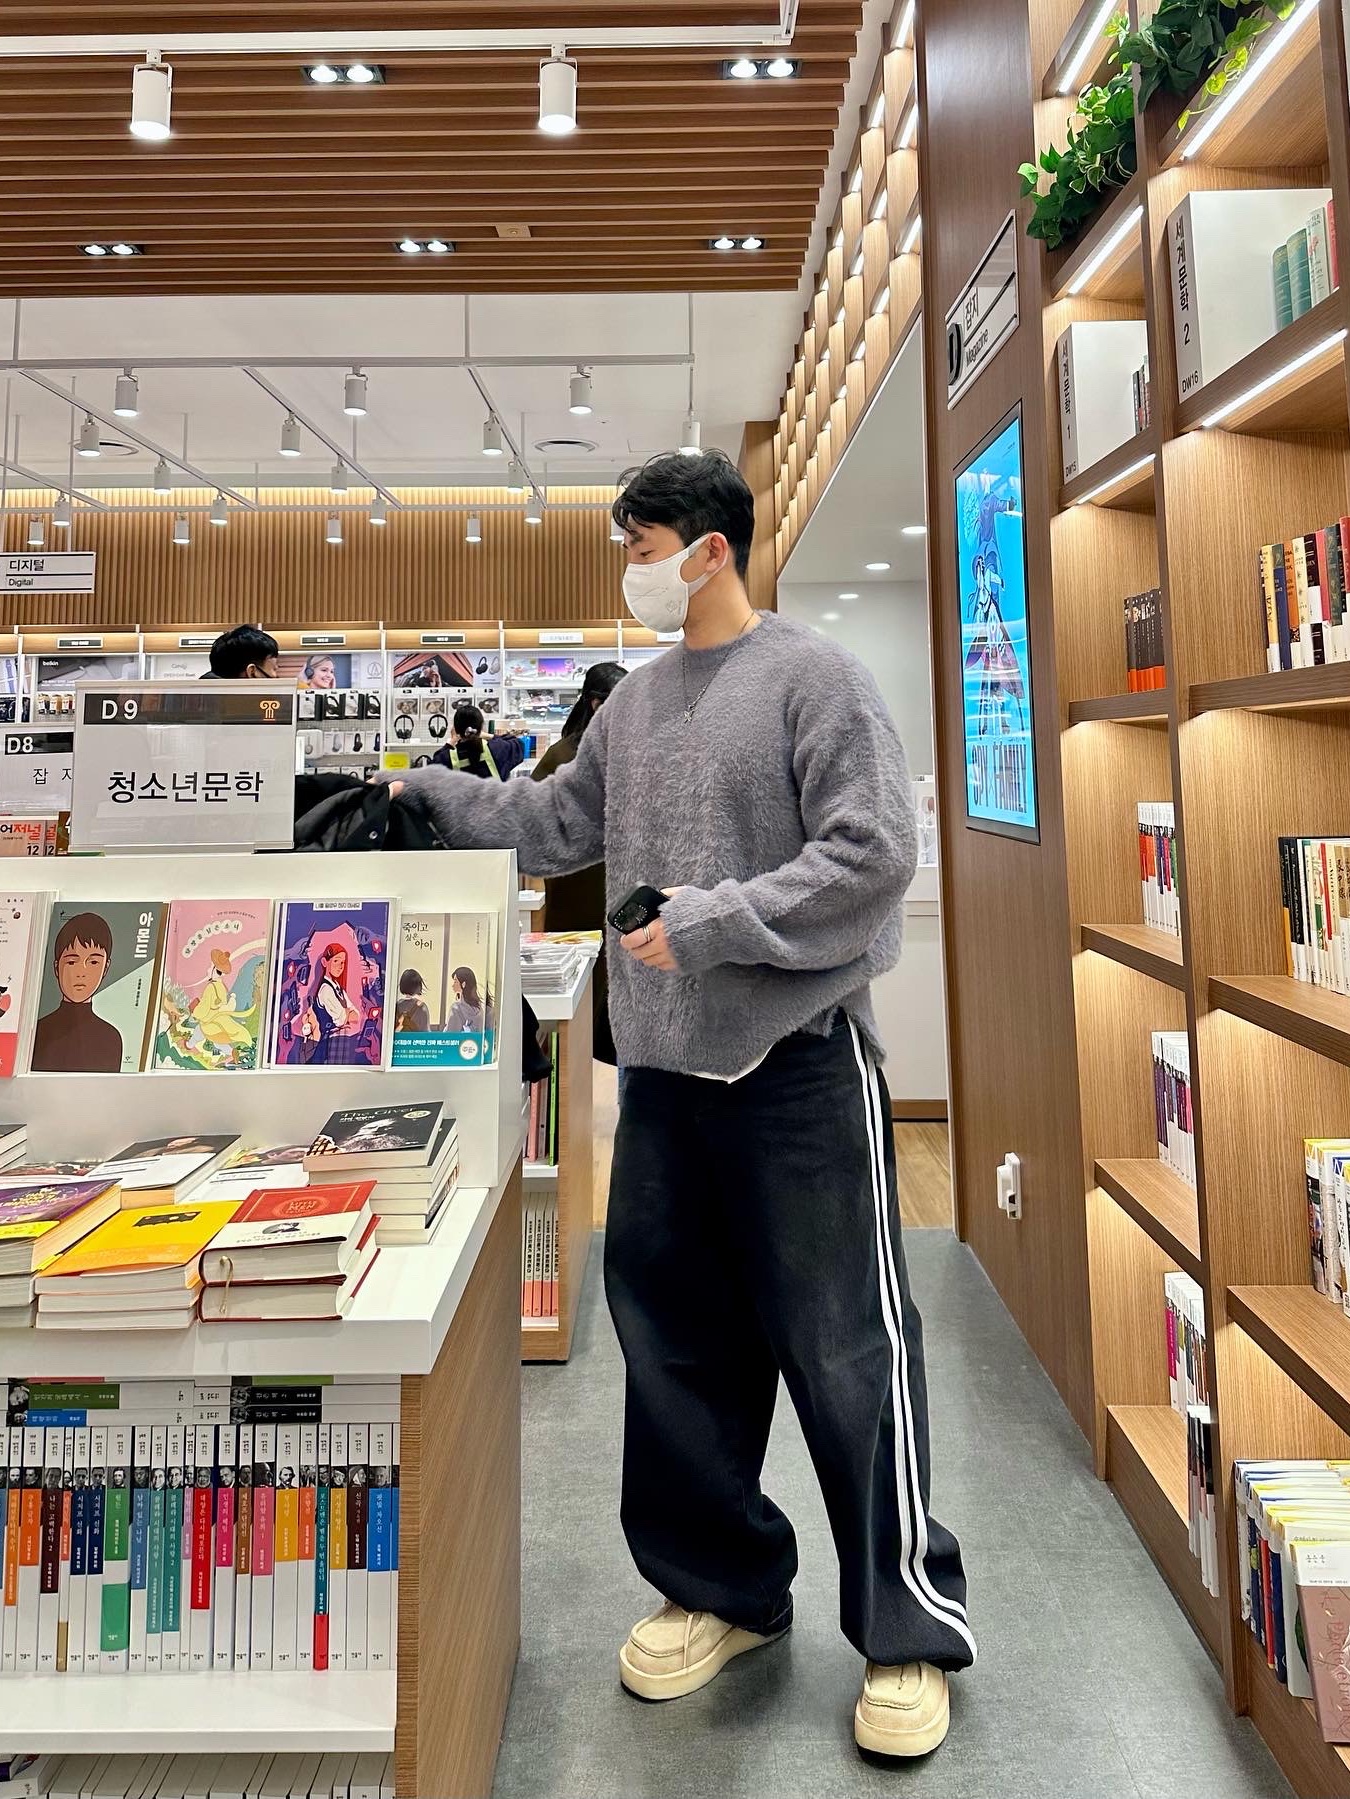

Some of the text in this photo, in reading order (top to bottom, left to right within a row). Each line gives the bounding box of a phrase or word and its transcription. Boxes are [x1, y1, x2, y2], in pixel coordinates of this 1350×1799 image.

[965, 286, 979, 331] 잡지
[1183, 322, 1191, 346] 2
[947, 322, 963, 386] D
[1181, 370, 1199, 393] DW16
[9, 559, 45, 572] 디지털
[8, 577, 34, 588] Digital
[7, 736, 34, 755] D8
[107, 770, 264, 803] 청소년문학
[971, 744, 989, 808] SPY
[992, 741, 1028, 814] FAMILY
[26, 845, 40, 856] 12
[133, 911, 154, 959] 아몬드
[402, 921, 429, 933] 죽이고
[405, 932, 418, 942] 싶은
[414, 938, 433, 951] 아이
